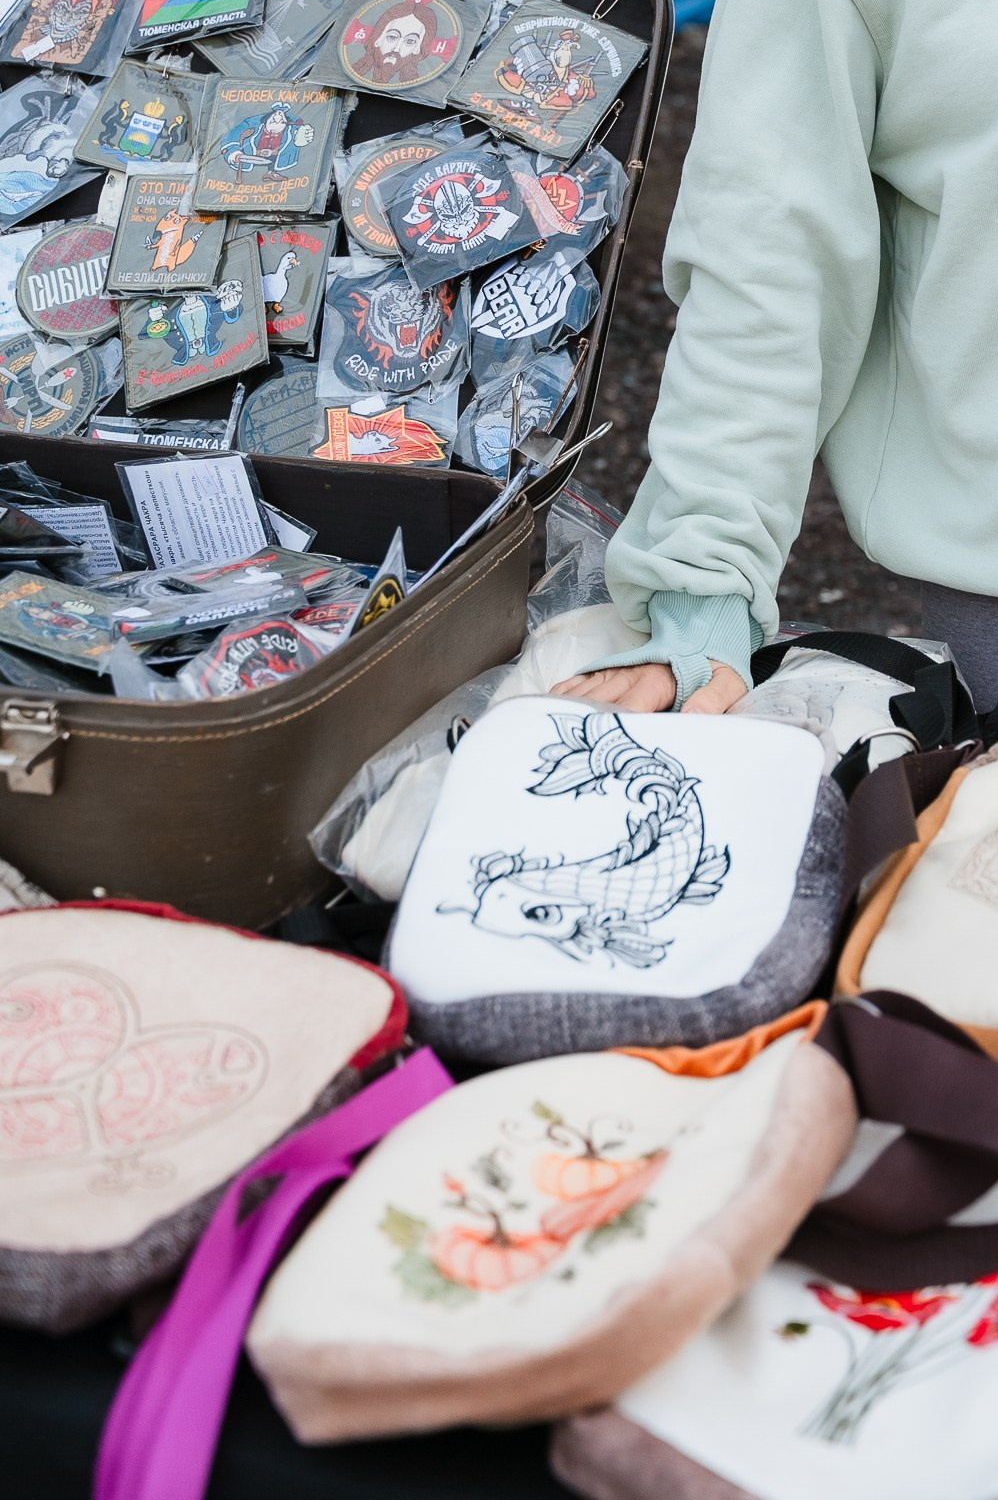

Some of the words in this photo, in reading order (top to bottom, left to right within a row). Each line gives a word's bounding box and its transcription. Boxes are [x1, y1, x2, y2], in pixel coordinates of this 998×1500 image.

[139, 19, 200, 37] ТЮМЕНСКАЯ
[202, 10, 247, 27] ОБЛАСТЬ
[513, 16, 580, 35] НЕПРИЯТНОСТИ
[580, 21, 601, 39] УЖЕ
[599, 36, 623, 78] СЛУЧИЛИСЬ
[220, 89, 275, 102] ЧЕЛОВЕК
[278, 89, 301, 103] КАК
[302, 91, 329, 104] НОЖ
[354, 146, 440, 191] МИНИСТЕРСТ
[139, 182, 164, 194] ЭТО
[203, 178, 234, 192] ЛИБО
[235, 182, 277, 195] ДЕЛАЕТ
[278, 176, 310, 192] ДЕЛО
[136, 195, 156, 205] ОНА
[158, 196, 191, 206] ОЧЕН
[219, 193, 249, 203] ЛИБО
[252, 191, 289, 203] ТУПОЙ
[353, 213, 368, 229] НЕ
[281, 229, 323, 255] НОЖОМ
[117, 272, 133, 282] НЕ
[133, 272, 154, 282] ЗЛИ
[154, 272, 207, 283] ЛИСИЧКУ!
[483, 278, 526, 338] BEAR
[345, 354, 379, 380] RIDE
[383, 367, 416, 384] WITH
[419, 338, 459, 375] PRIDE
[142, 434, 230, 451] ТЮМЕНСКАЯ
[139, 499, 152, 525] ЧАКРА
[262, 633, 299, 653] RIDE
